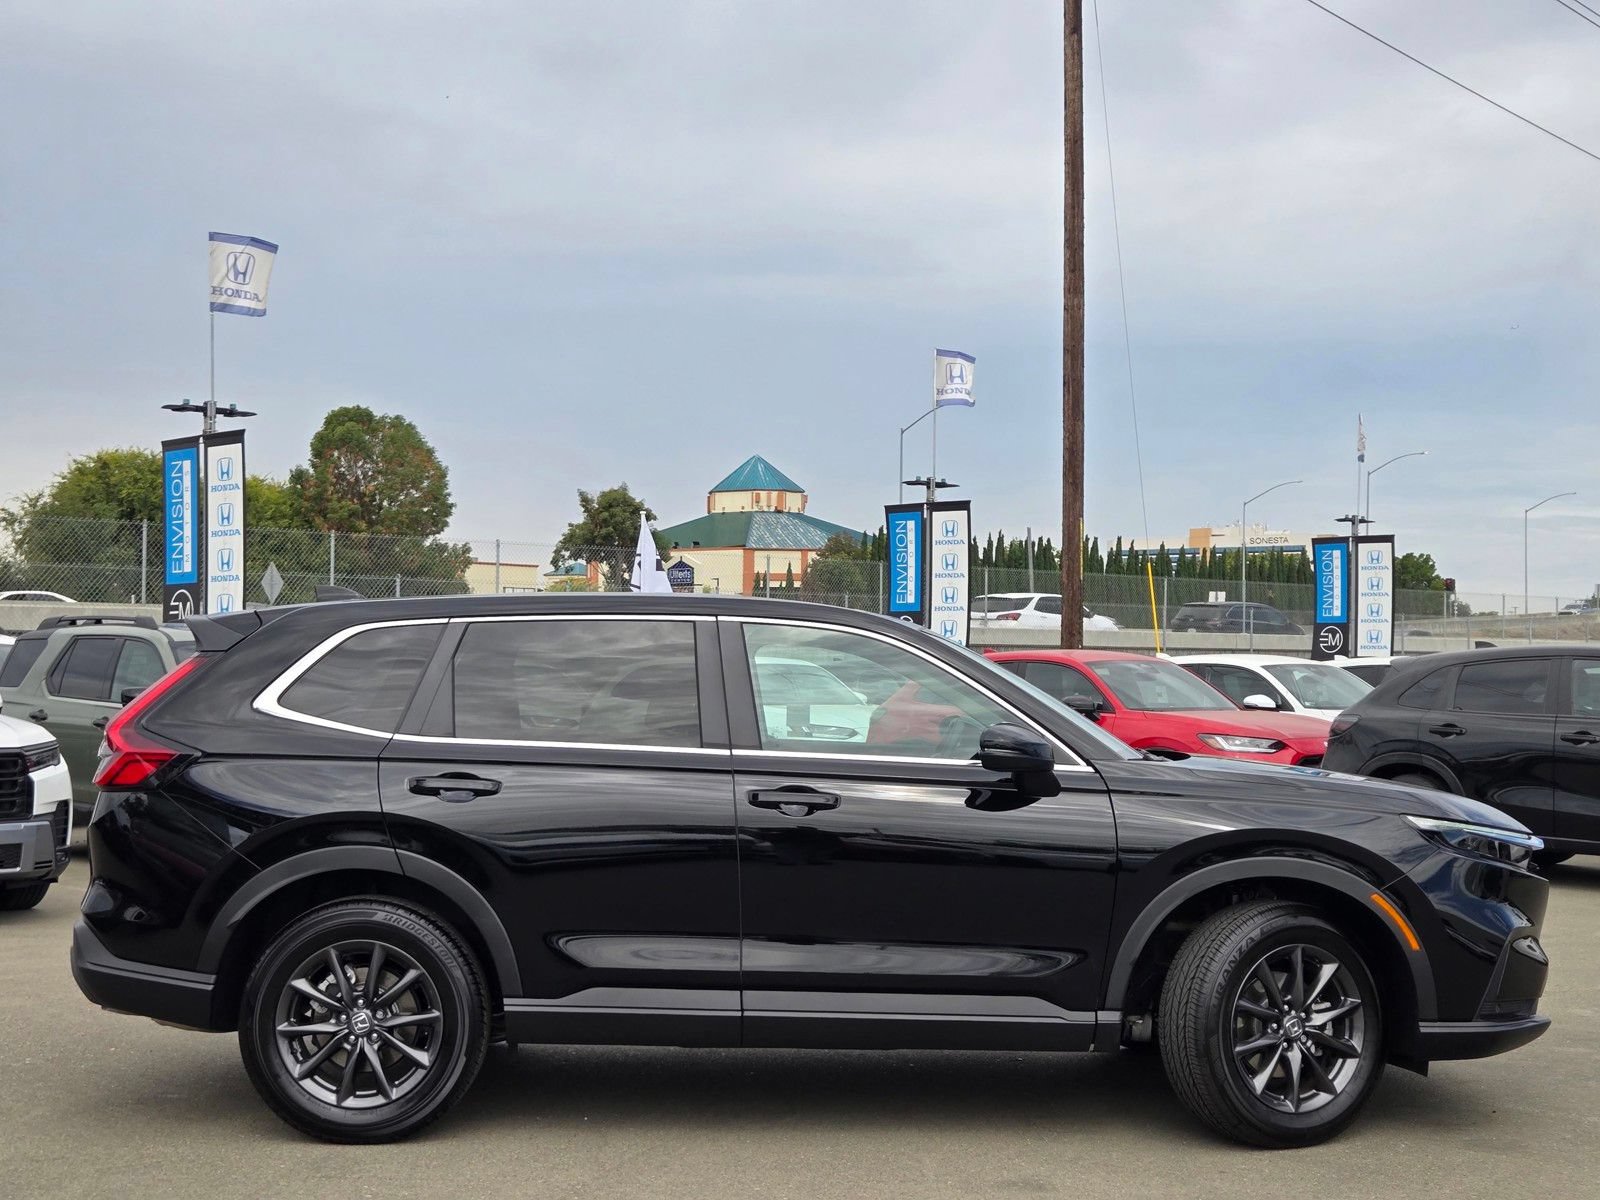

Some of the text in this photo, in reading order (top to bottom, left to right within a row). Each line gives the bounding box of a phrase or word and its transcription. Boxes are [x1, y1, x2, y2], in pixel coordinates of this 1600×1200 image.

[210, 285, 262, 303] HONDA
[210, 483, 241, 493] HONDA
[171, 460, 183, 574] ENVISION
[210, 528, 241, 538] HONDA
[1249, 536, 1289, 545] SONESTA
[895, 520, 908, 604] ENVISION
[210, 574, 241, 583] HONDA
[1321, 550, 1334, 617] ENVISION
[382, 913, 459, 971] BRIDGESTONE
